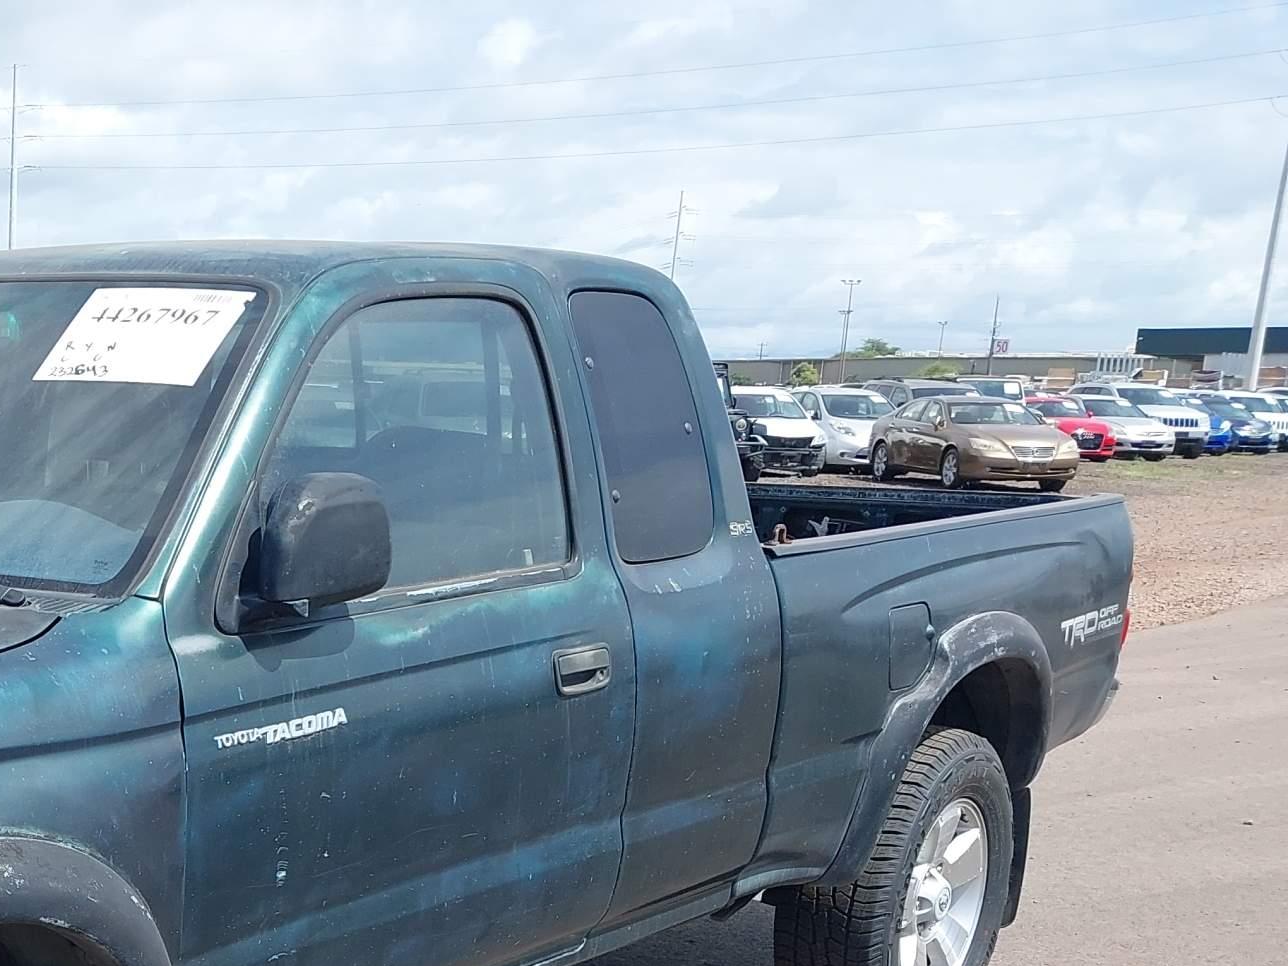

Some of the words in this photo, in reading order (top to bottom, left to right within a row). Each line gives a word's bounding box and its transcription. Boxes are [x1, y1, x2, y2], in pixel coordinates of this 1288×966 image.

[92, 307, 221, 326] 44267967
[995, 341, 1009, 353] 50
[1060, 610, 1099, 648] TRD
[1099, 603, 1120, 619] OFF
[1097, 614, 1124, 631] ROAD
[214, 727, 263, 749] TOYOTA
[262, 707, 349, 744] TACOMA
